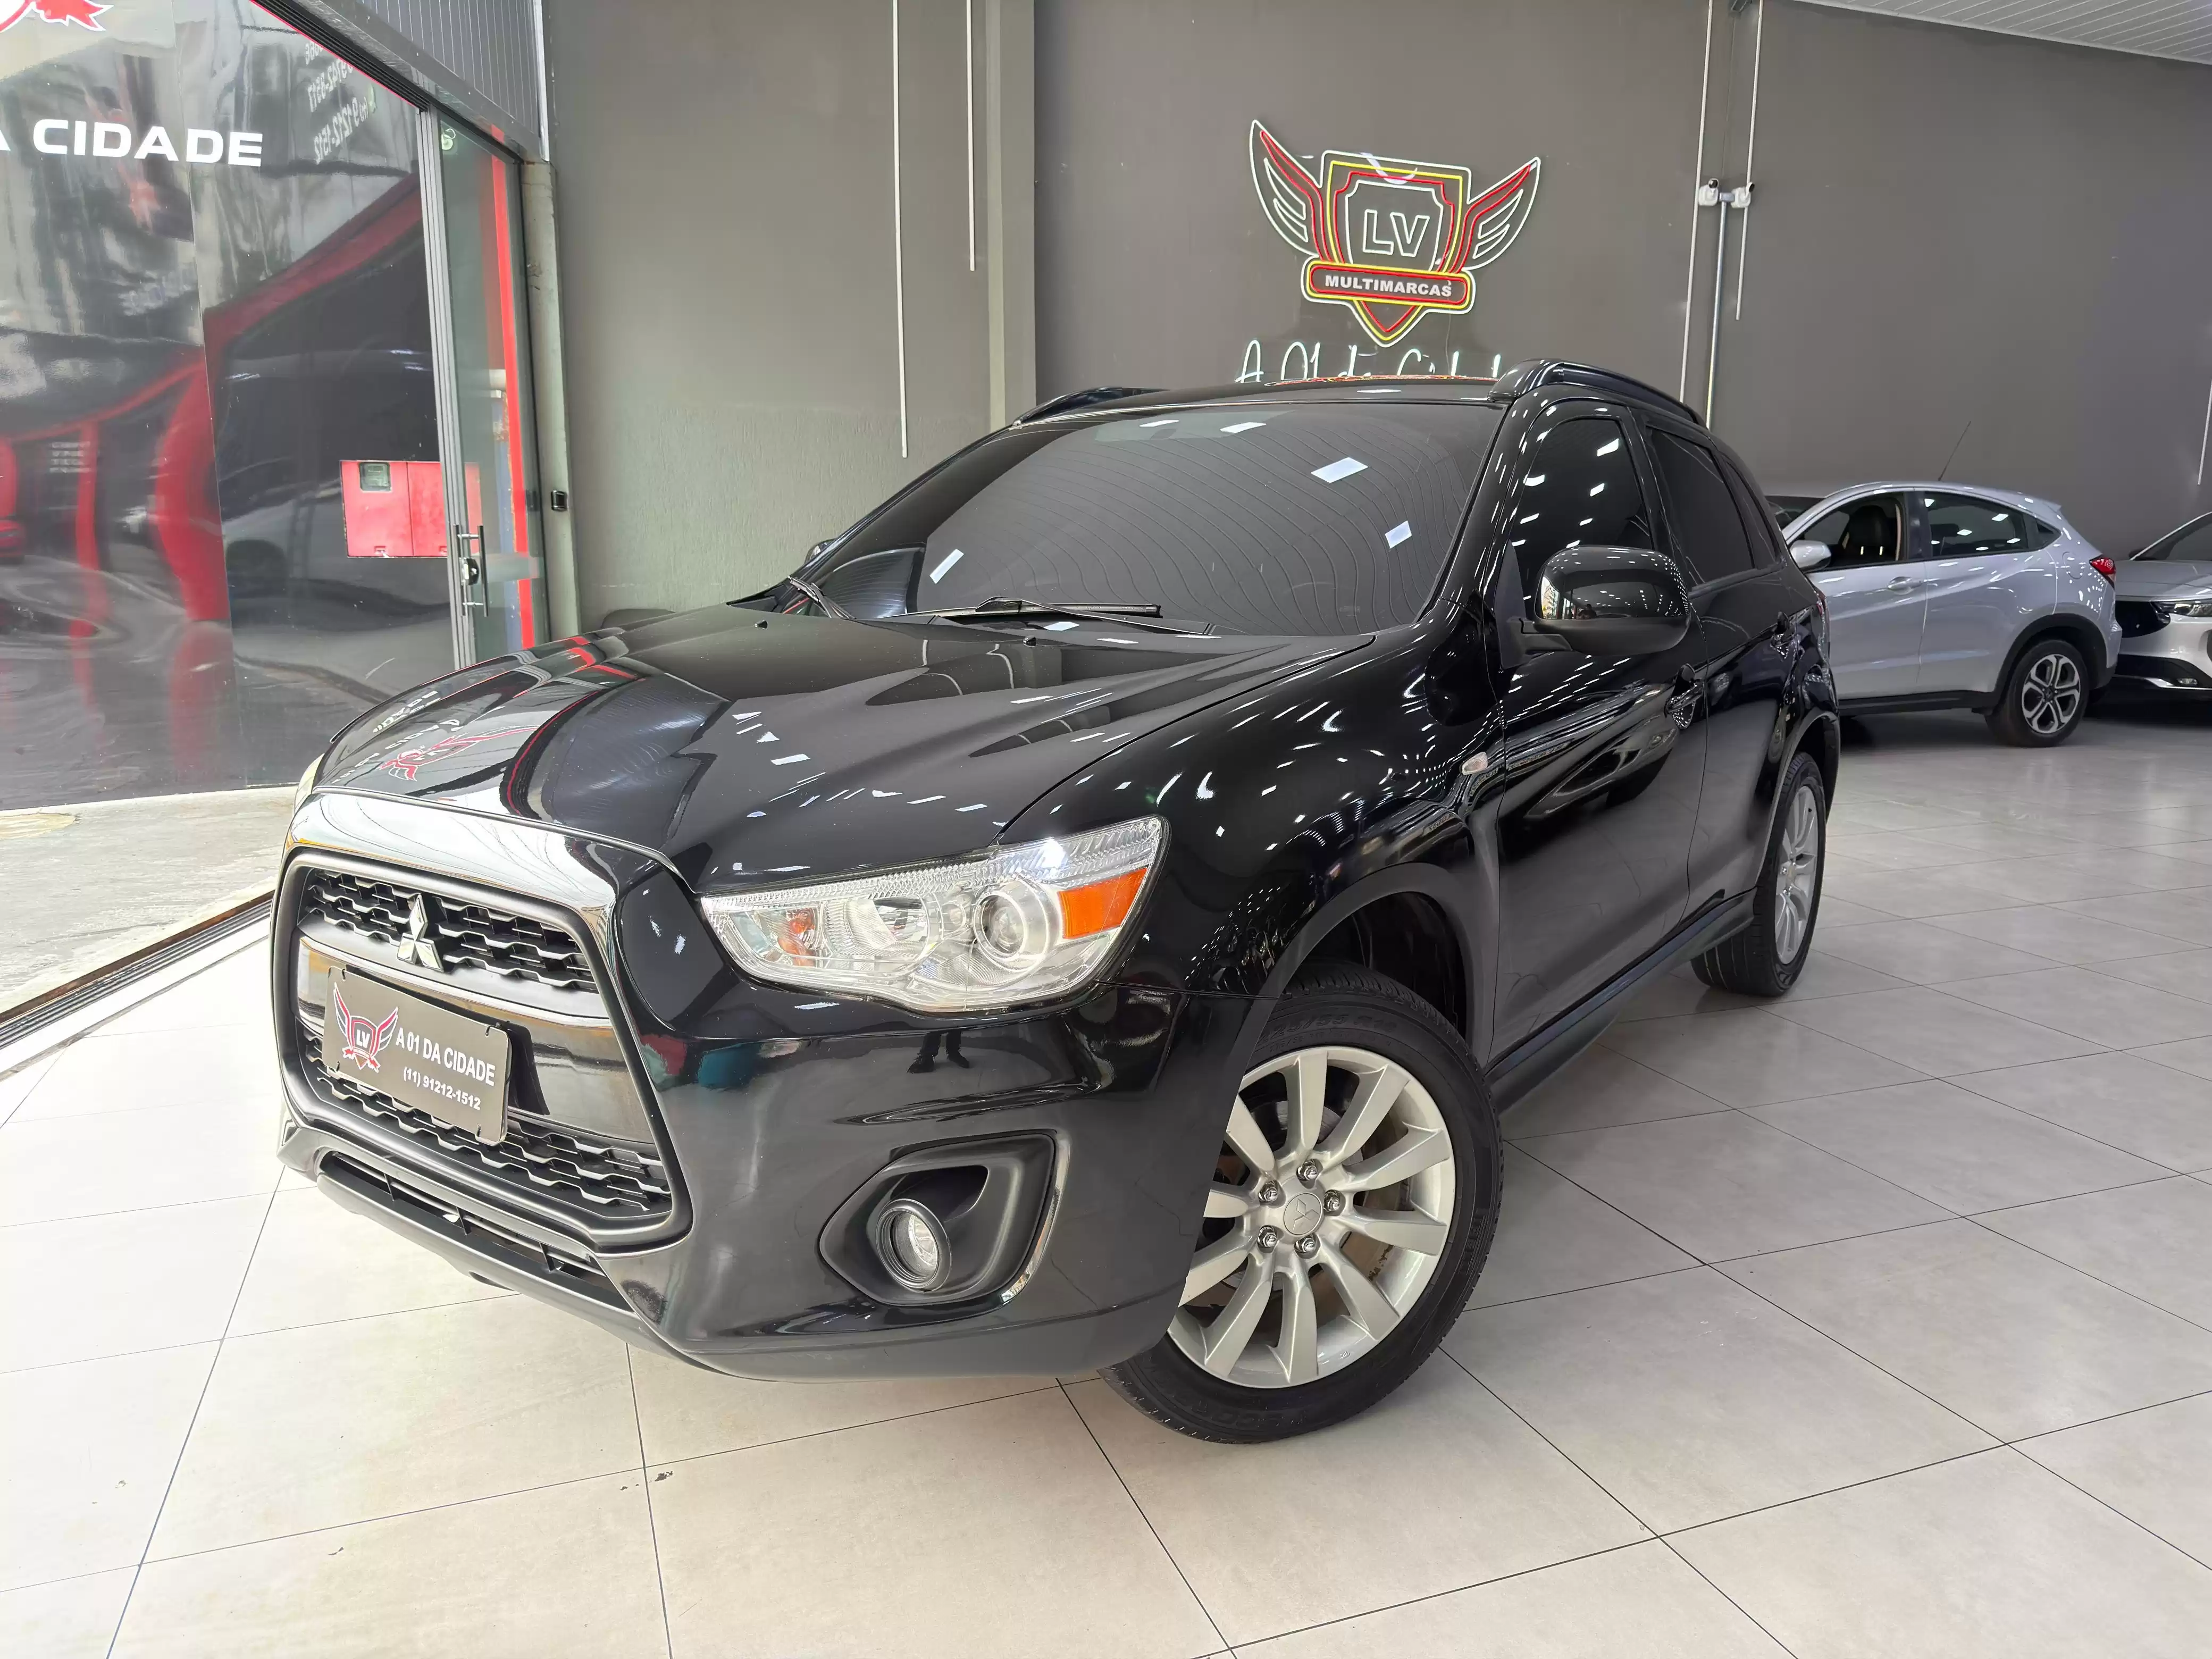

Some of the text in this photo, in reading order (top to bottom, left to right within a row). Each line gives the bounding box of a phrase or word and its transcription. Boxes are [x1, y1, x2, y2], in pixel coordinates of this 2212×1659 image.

[33, 118, 263, 167] CIDADE
[1362, 209, 1430, 257] LV
[1325, 274, 1452, 297] MULTIMARCAS
[356, 1029, 371, 1049] LV
[396, 1027, 496, 1086] A 01 DA CIDADE
[403, 1066, 481, 1110] (11) 91212-1512
